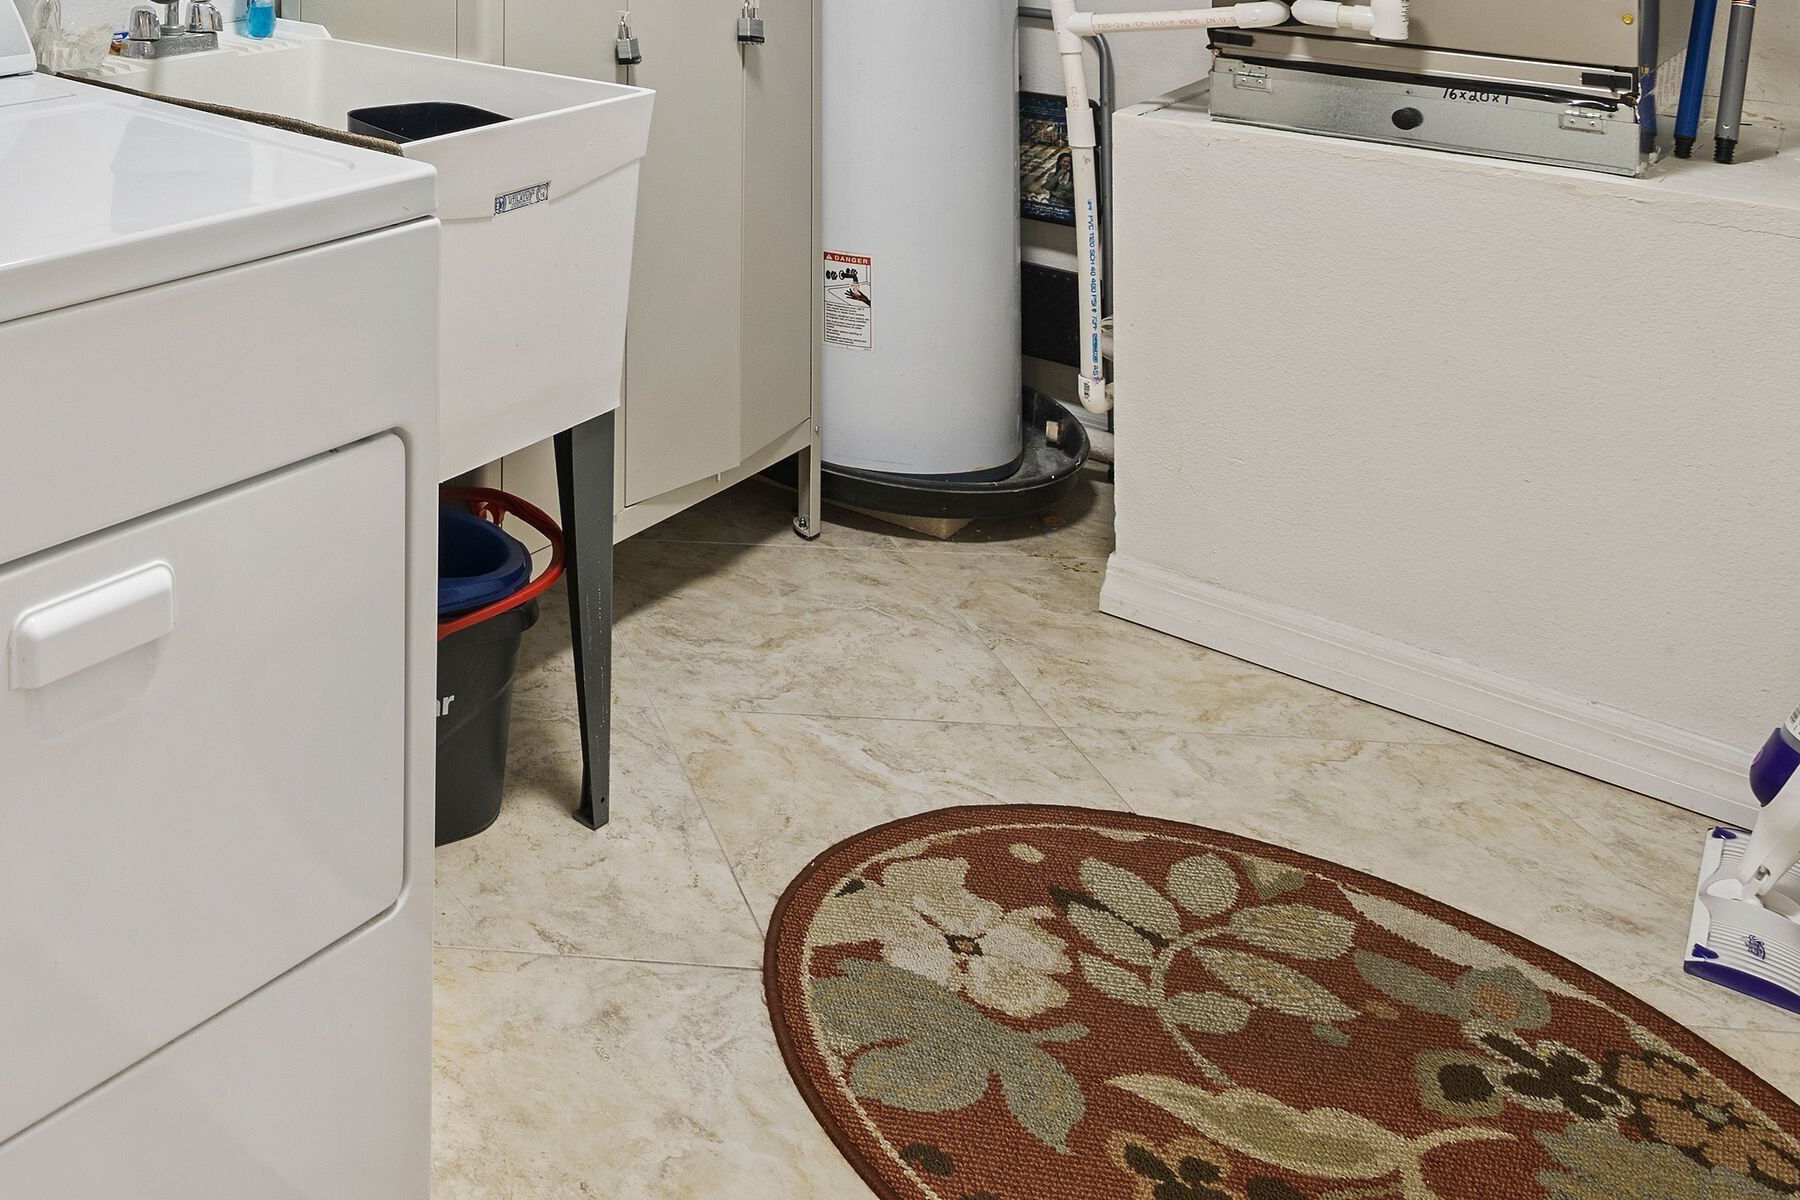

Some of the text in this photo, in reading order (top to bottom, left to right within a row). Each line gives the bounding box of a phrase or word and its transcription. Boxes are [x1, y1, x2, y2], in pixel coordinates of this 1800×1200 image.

[1087, 215, 1095, 231] PVC
[834, 255, 868, 264] DANGER
[1090, 266, 1097, 276] 40
